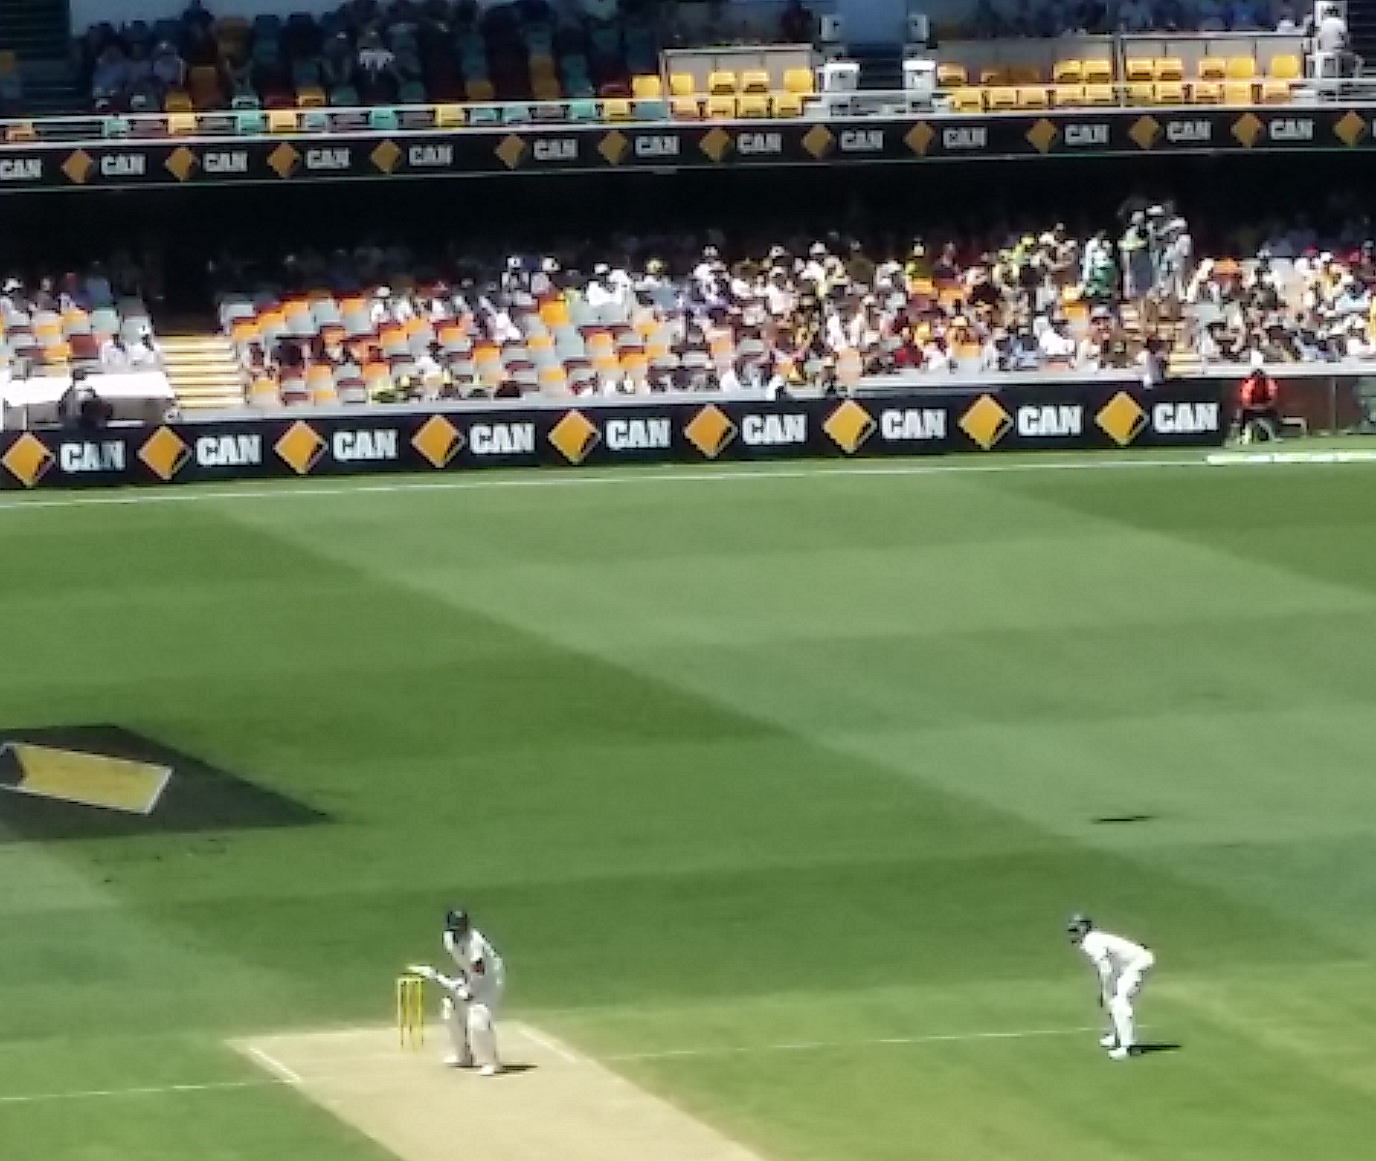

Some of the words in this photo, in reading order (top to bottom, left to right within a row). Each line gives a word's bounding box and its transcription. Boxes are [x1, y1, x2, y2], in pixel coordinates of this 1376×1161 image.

[943, 127, 988, 148] CAN
[1064, 123, 1110, 145] CAN
[1166, 120, 1212, 141] CAN
[1269, 118, 1315, 139] CAN
[533, 138, 578, 160] CAN
[635, 135, 680, 156] CAN
[737, 132, 782, 153] CAN
[840, 130, 884, 151] CAN
[101, 155, 146, 176] CAN
[204, 152, 248, 173] CAN
[308, 148, 351, 170] CAN
[408, 145, 453, 166] CAN
[881, 408, 947, 440] CAN
[1017, 404, 1084, 436] CAN
[1153, 402, 1221, 433] CAN
[469, 423, 535, 455] CAN
[605, 418, 671, 450] CAN
[741, 414, 807, 446] CAN
[196, 435, 262, 465] CAN
[333, 430, 398, 460] CAN
[60, 442, 124, 473] CAN
